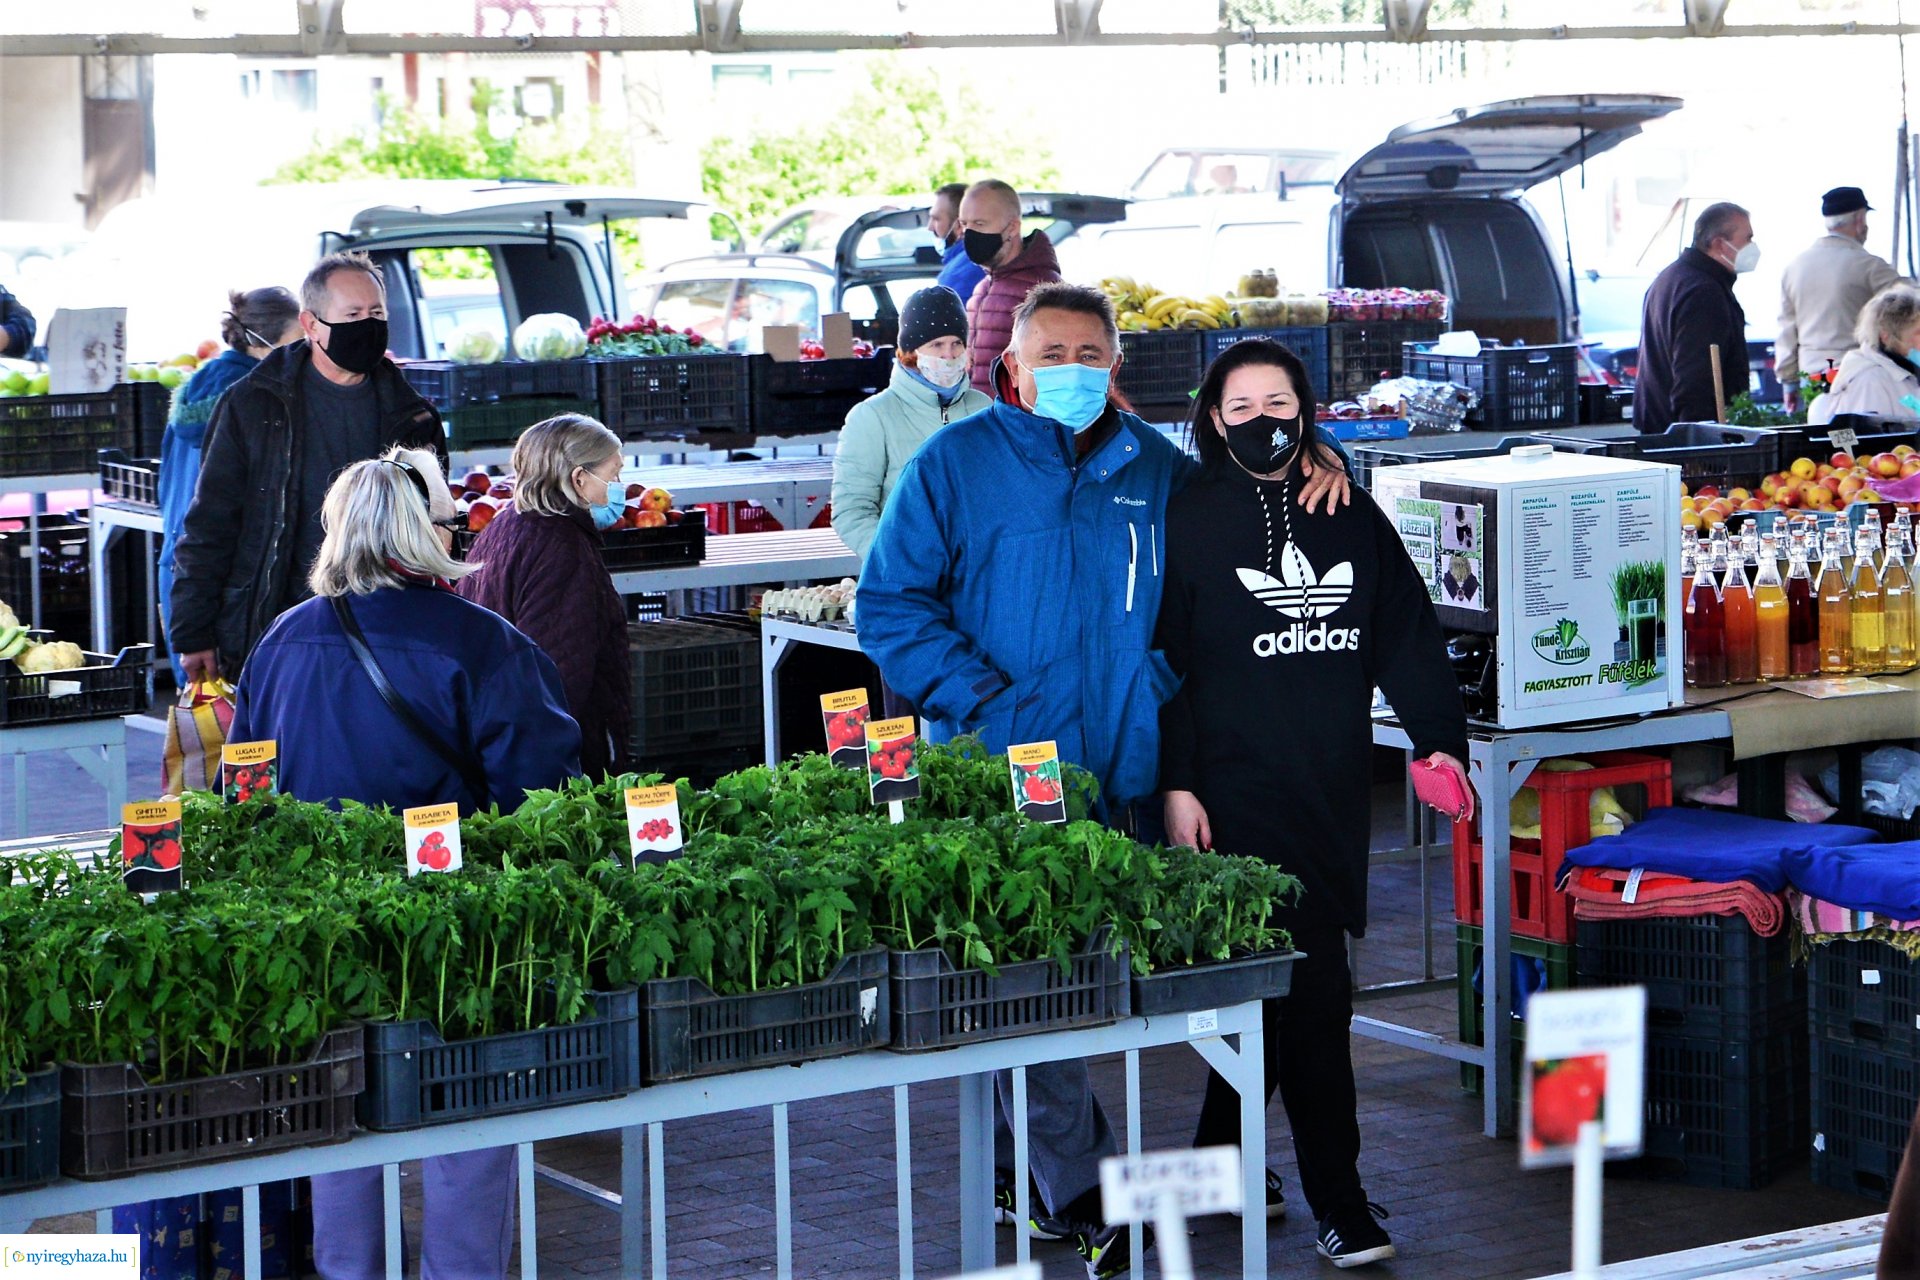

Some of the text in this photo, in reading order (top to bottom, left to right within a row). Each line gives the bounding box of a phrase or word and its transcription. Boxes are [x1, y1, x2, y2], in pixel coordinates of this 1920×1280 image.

[1253, 622, 1360, 657] adidas
[1534, 632, 1561, 648] Tünde
[1598, 659, 1656, 684] Fűfélék
[1524, 674, 1593, 693] FAGYASZTOTT
[832, 695, 856, 704] BRUTUS
[413, 810, 451, 820] ELISABETA
